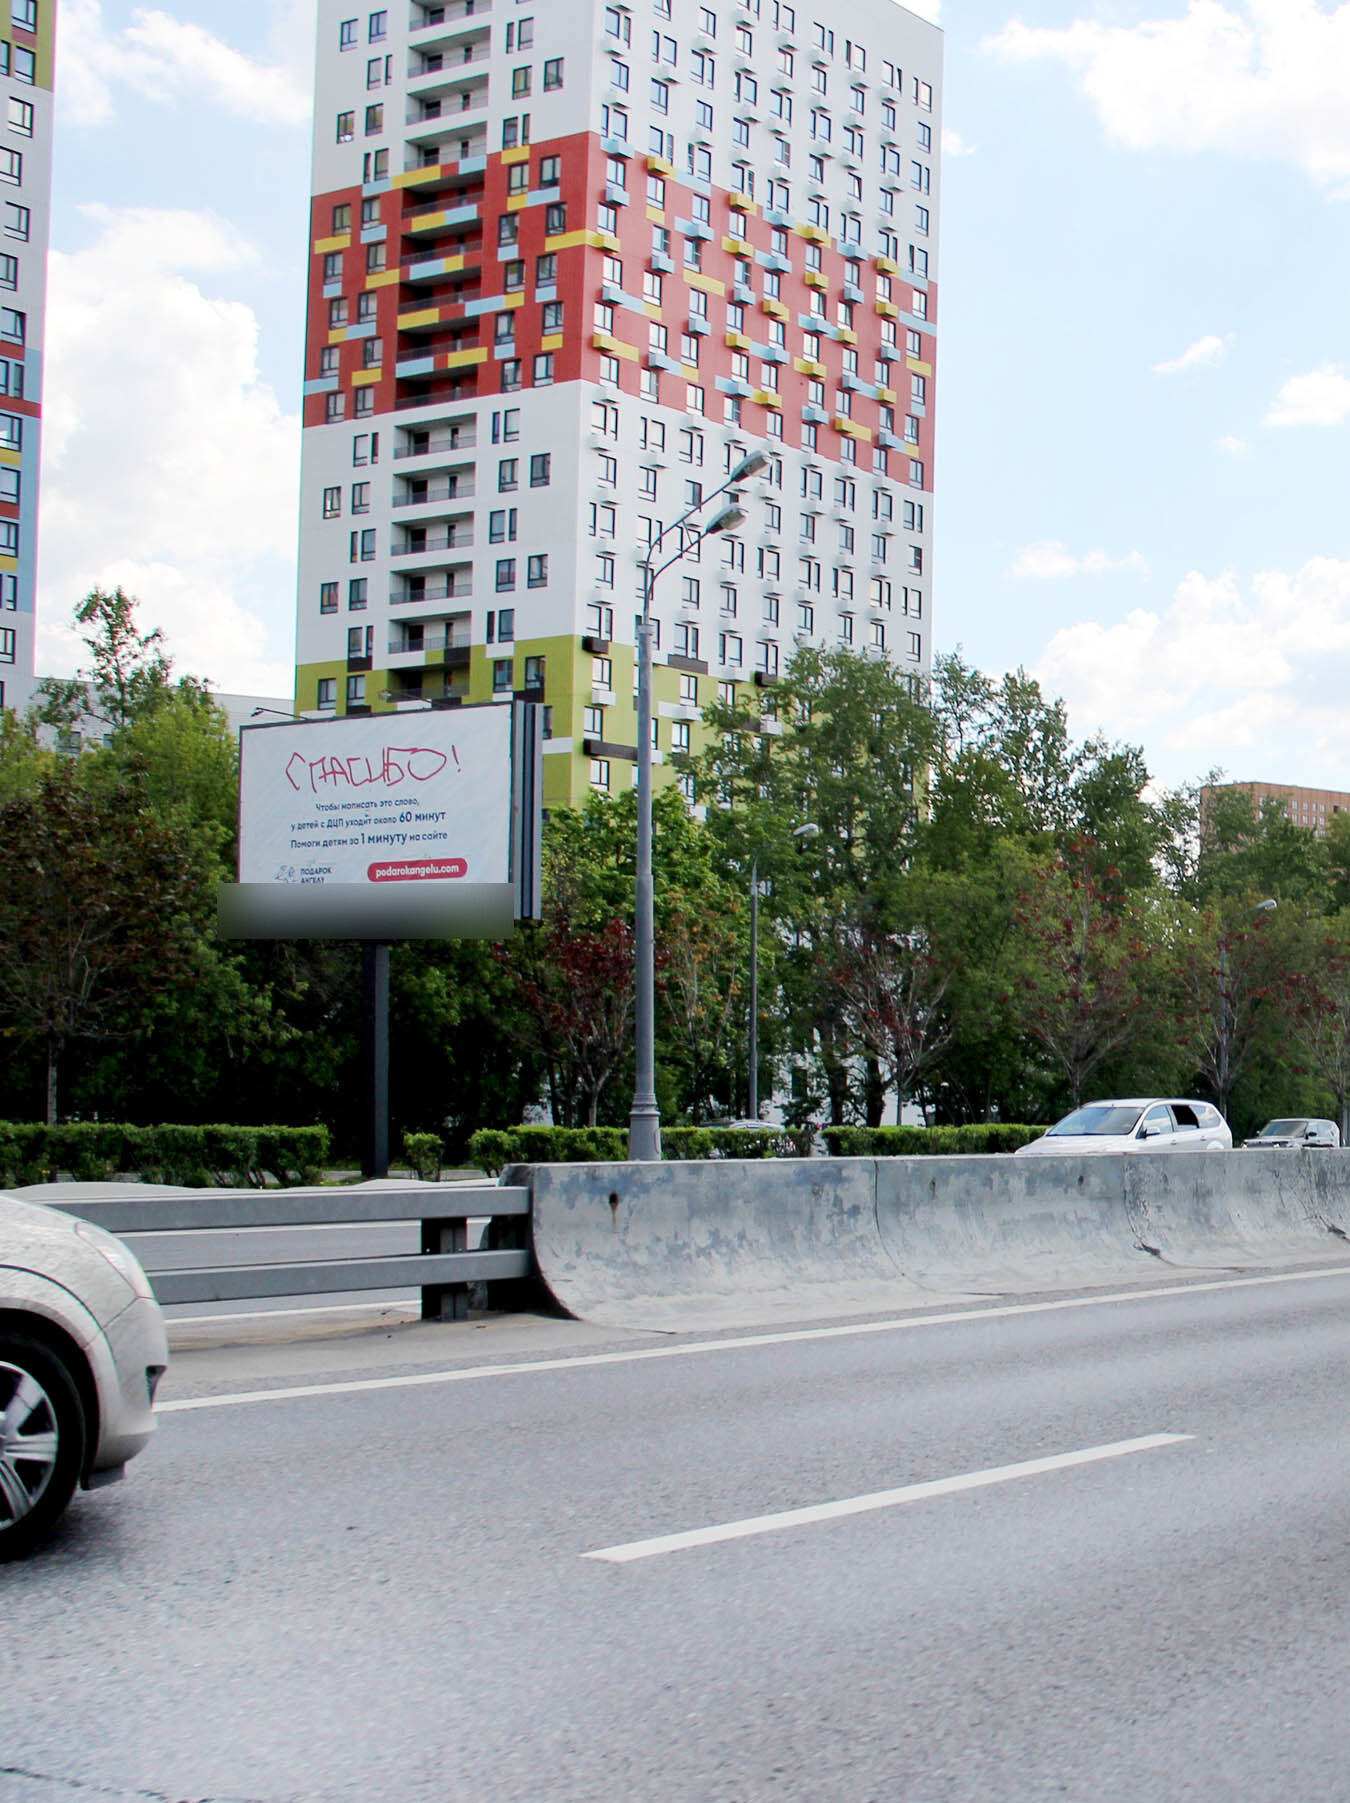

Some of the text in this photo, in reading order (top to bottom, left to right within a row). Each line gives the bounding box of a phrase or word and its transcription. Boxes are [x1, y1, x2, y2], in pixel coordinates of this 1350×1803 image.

[316, 798, 420, 812] Чтобы написать это слово,
[297, 820, 319, 830] детей
[326, 818, 344, 829] ДЦП
[345, 816, 372, 827] уходит
[373, 816, 397, 825] около
[399, 811, 412, 823] 60
[415, 811, 446, 822] минут
[291, 838, 321, 849] Помоги
[322, 839, 348, 848] детям
[361, 833, 366, 845] 1
[367, 833, 408, 846] минуту
[409, 834, 421, 842] на
[421, 830, 448, 841] сайте
[301, 866, 333, 876] ПОДАРОК
[375, 863, 460, 880] podarokangelu.com
